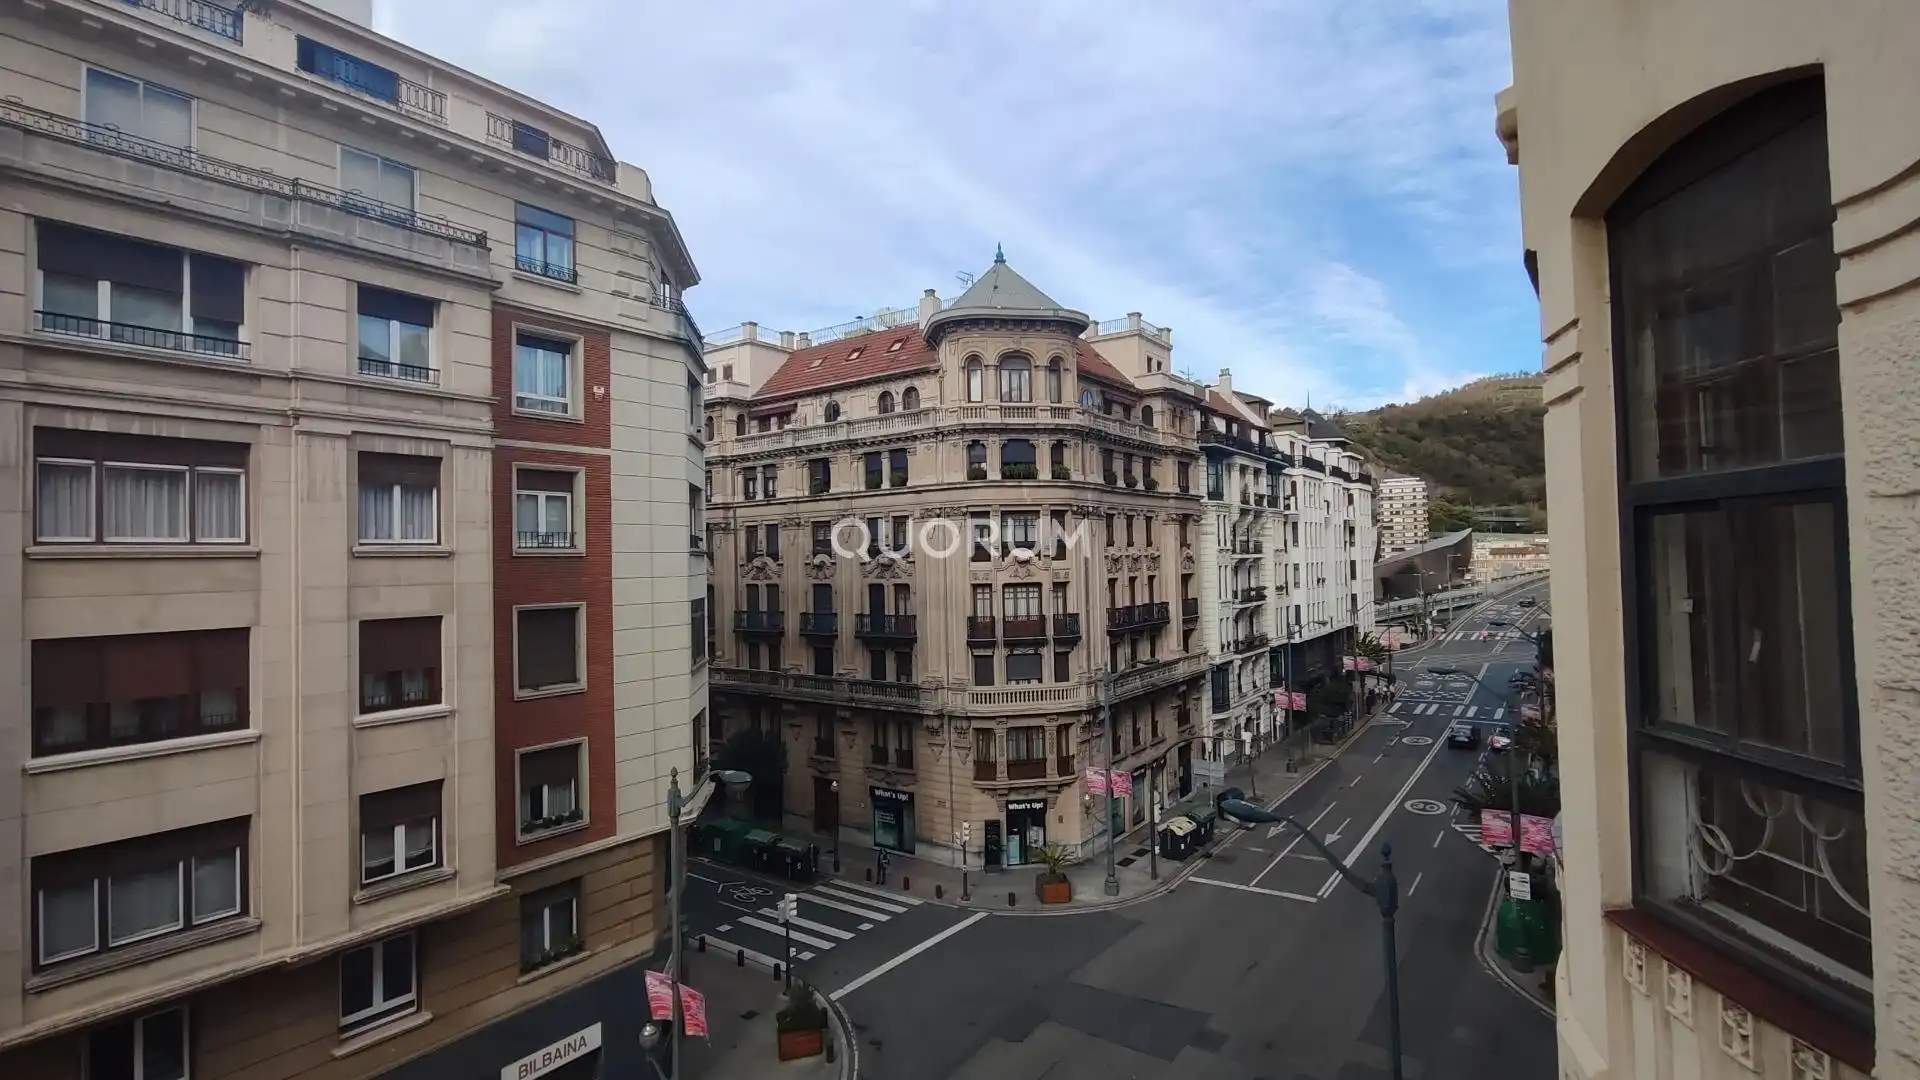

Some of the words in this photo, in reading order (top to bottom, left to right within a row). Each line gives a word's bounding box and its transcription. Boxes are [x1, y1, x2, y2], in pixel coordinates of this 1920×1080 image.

[874, 789, 896, 800] What's
[897, 791, 909, 801] Up!
[1008, 801, 1031, 810] What's
[1032, 801, 1044, 810] Up!
[518, 1035, 588, 1080] BILBAINA
